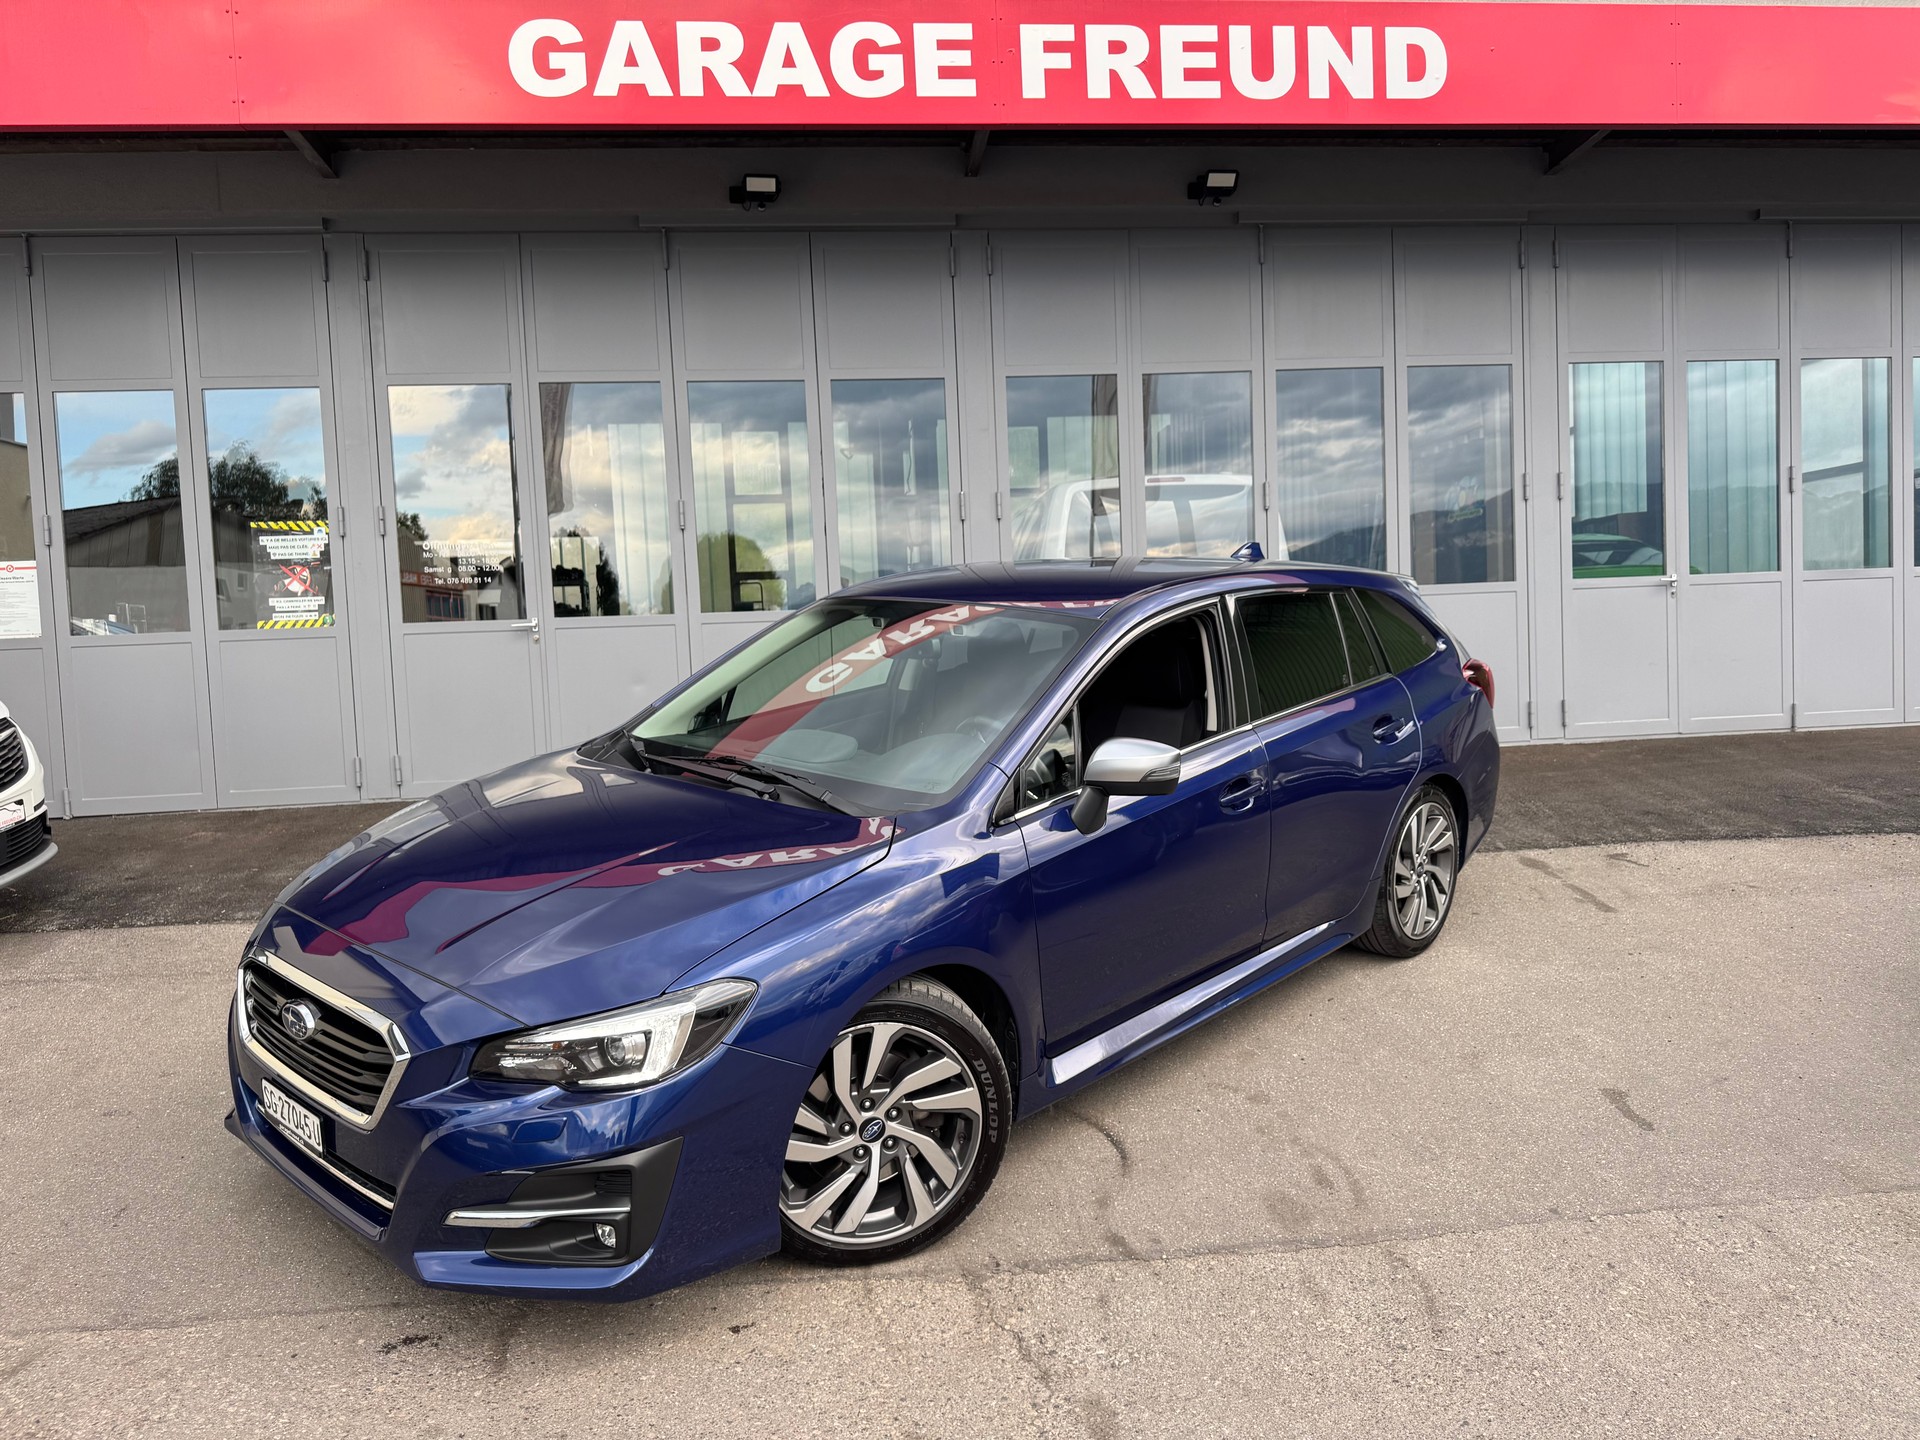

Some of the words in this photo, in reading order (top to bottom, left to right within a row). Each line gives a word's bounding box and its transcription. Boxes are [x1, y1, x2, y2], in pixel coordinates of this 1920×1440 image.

[508, 18, 977, 98] GARAGE
[1019, 24, 1448, 100] FREUND
[424, 566, 452, 574] Samstg
[435, 577, 446, 585] Tel.
[447, 577, 459, 585] 076
[973, 1057, 999, 1144] DUNLOP
